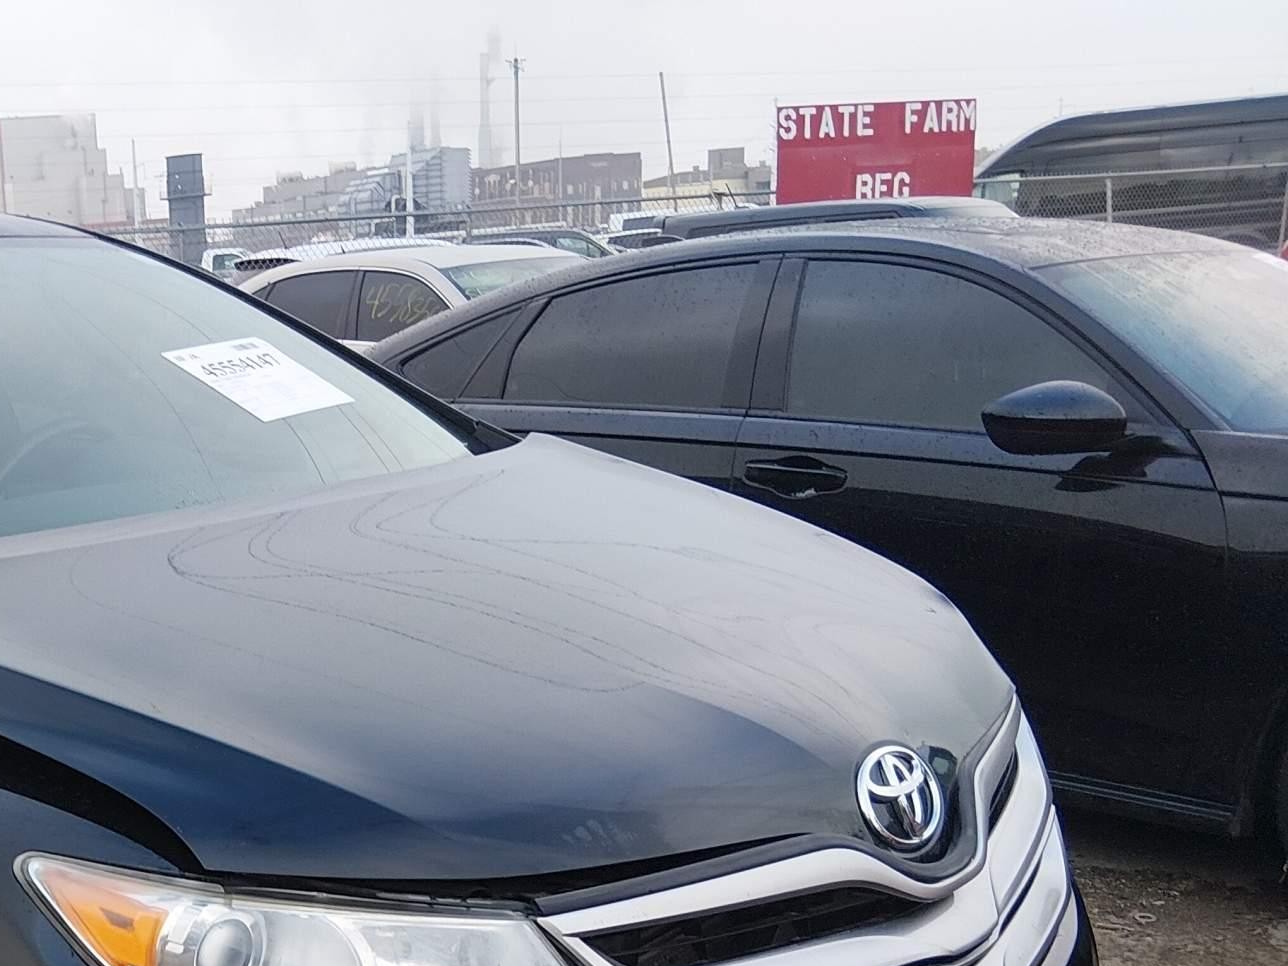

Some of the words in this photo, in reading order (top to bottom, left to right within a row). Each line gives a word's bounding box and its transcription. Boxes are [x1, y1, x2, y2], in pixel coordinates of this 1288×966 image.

[778, 105, 874, 140] STATE
[905, 101, 975, 134] FARM
[202, 353, 281, 377] 45554147
